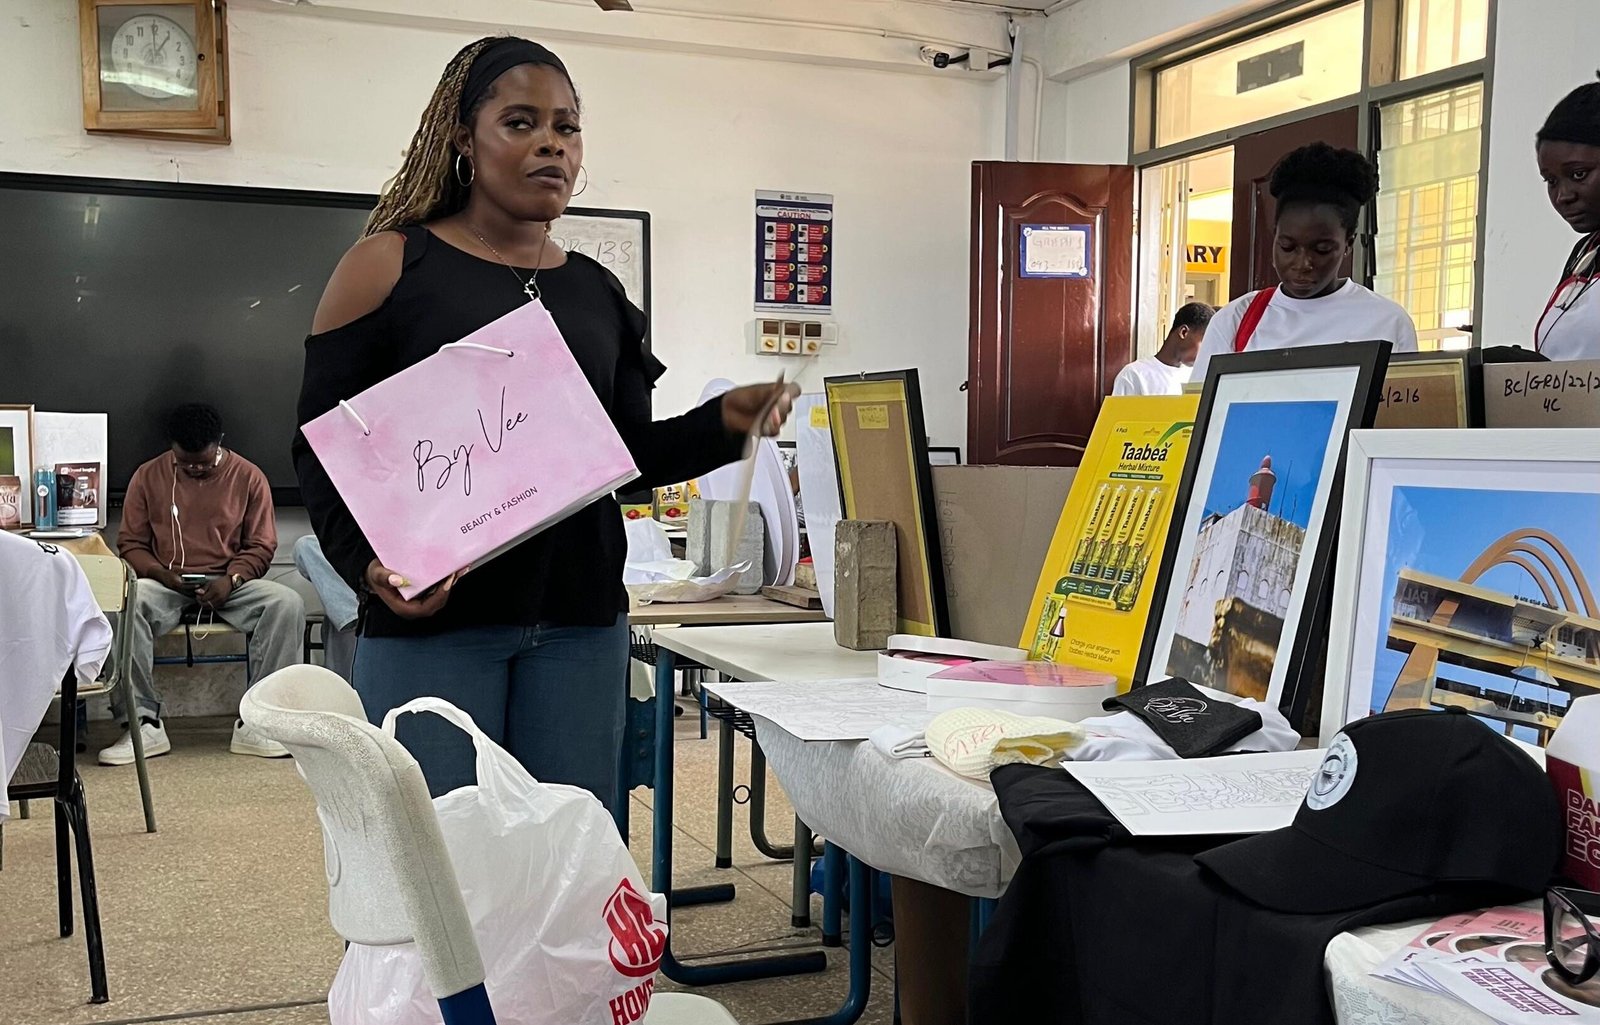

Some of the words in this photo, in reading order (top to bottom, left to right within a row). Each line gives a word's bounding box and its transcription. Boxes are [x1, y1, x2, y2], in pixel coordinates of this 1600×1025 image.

[137, 26, 144, 37] 11
[125, 35, 134, 46] 10
[176, 42, 182, 52] 2
[180, 56, 185, 66] 3
[176, 69, 181, 79] 4
[777, 211, 812, 219] CAUTION
[1543, 397, 1561, 413] 4C
[413, 439, 474, 496] By
[477, 386, 528, 453] Vee
[1118, 463, 1137, 471] Herbal
[1137, 463, 1161, 472] Mixture
[460, 511, 493, 534] BEAUTY
[493, 507, 502, 516] &
[501, 486, 538, 512] FASHION
[1567, 788, 1600, 816] DA
